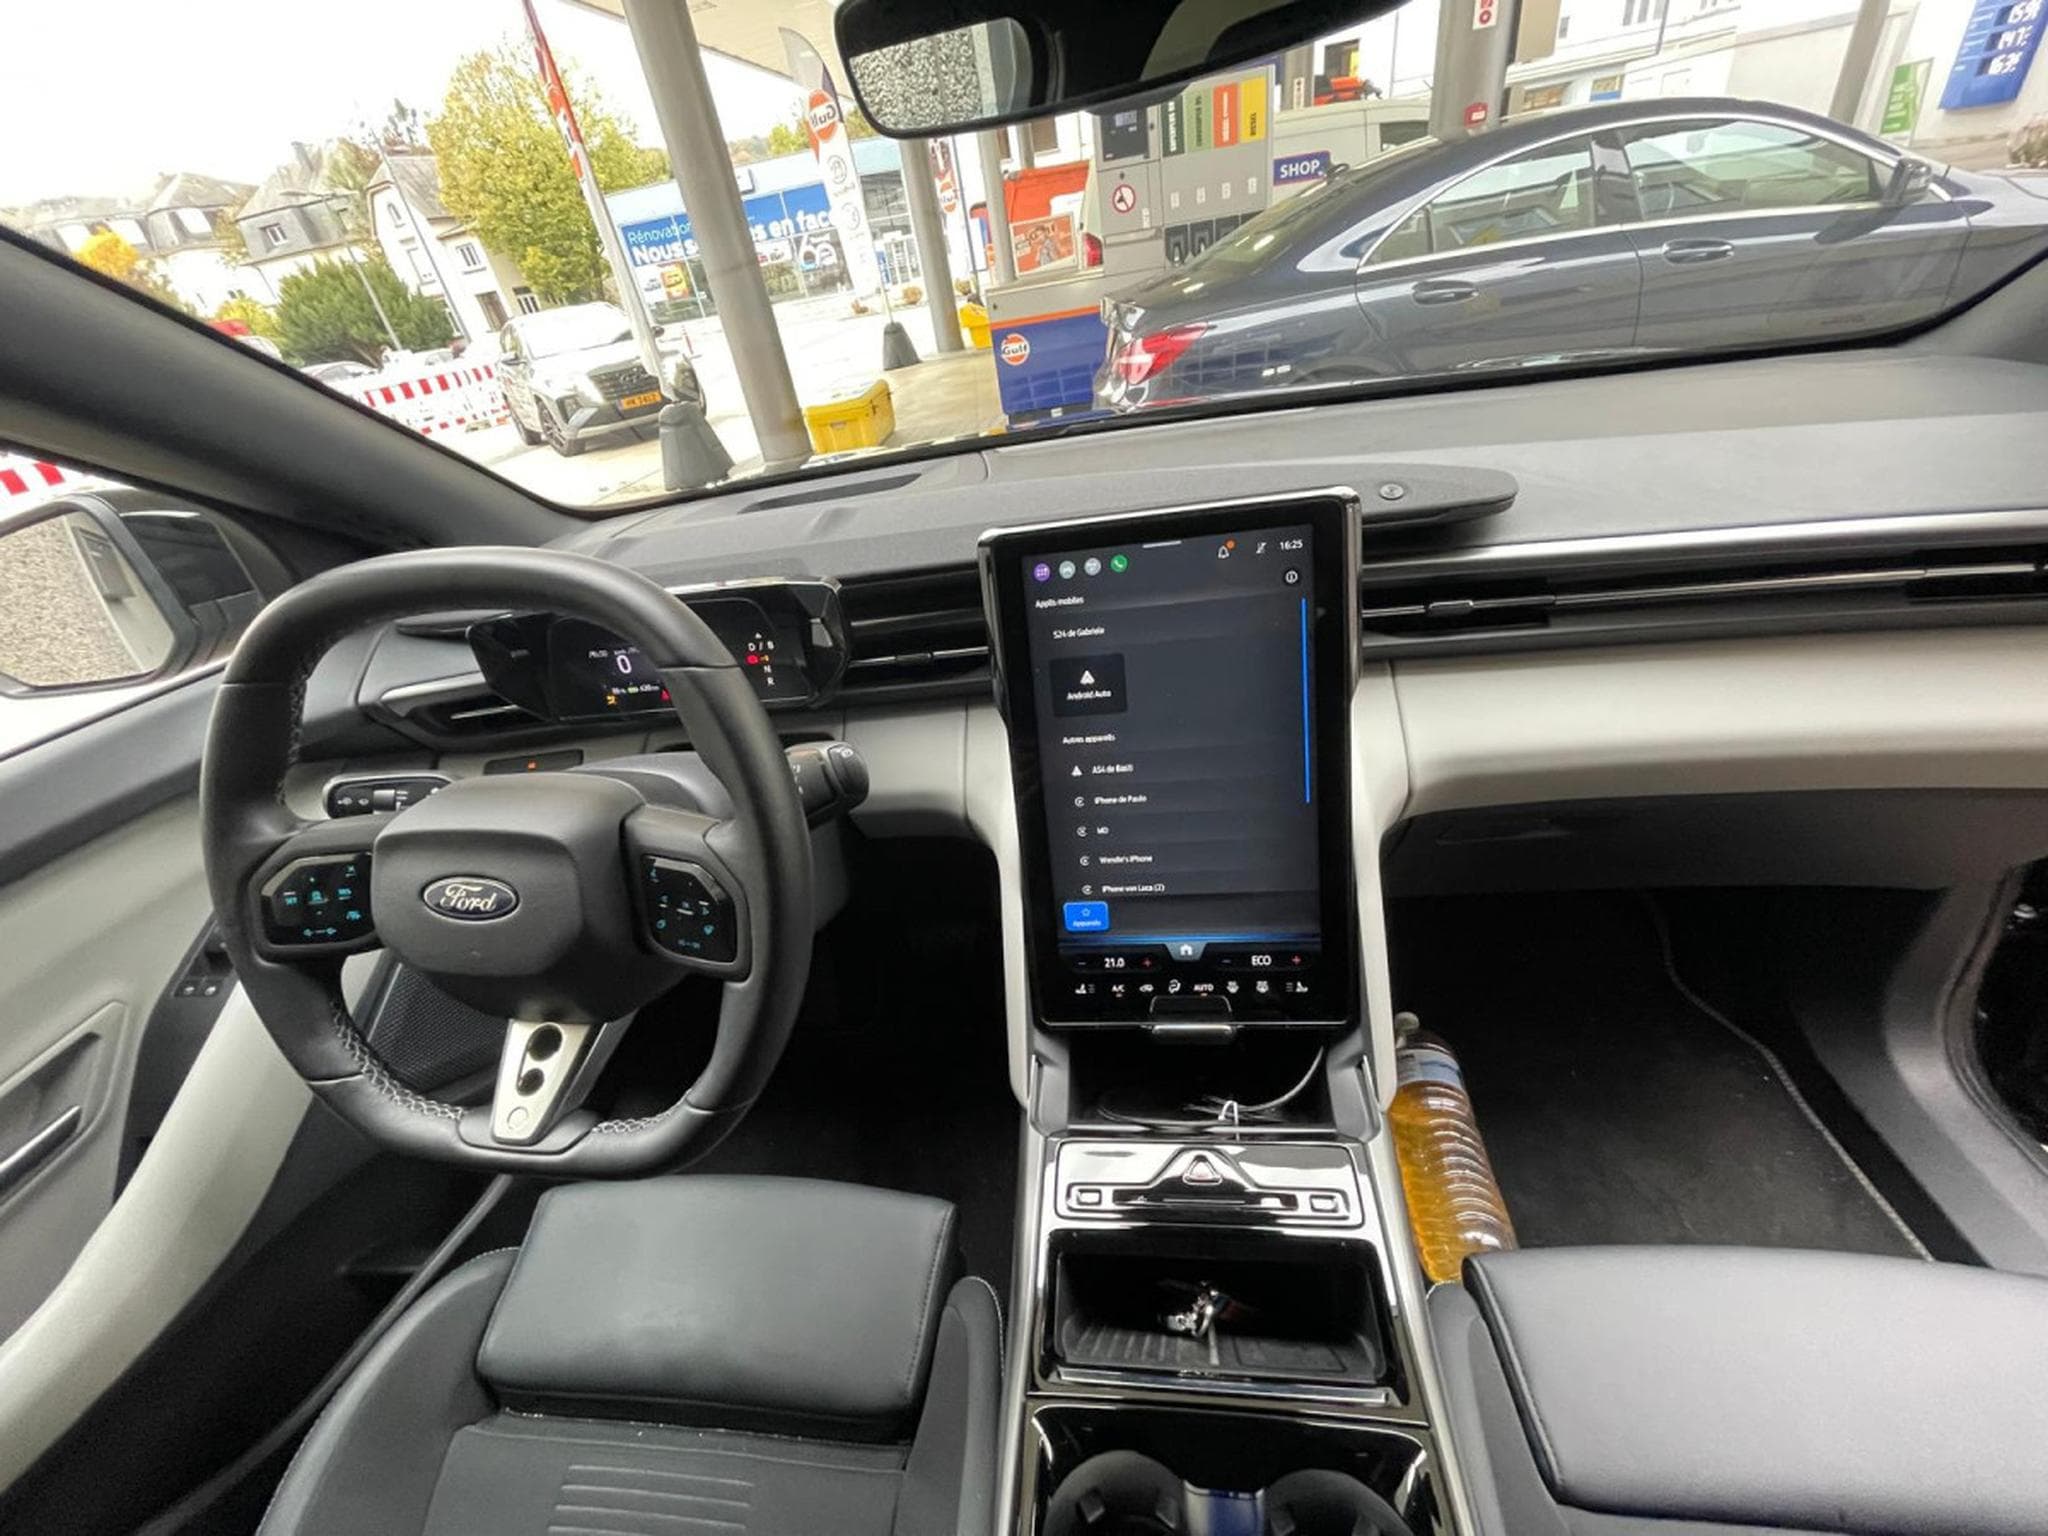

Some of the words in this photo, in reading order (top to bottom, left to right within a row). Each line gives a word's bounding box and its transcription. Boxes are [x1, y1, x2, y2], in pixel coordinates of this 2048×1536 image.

[1280, 159, 1320, 178] SHOP
[796, 208, 831, 234] fac
[627, 221, 692, 245] Rénovatio
[1002, 343, 1027, 355] Gulf
[1280, 539, 1303, 550] 16:25
[1058, 596, 1084, 605] mobiles
[616, 654, 632, 674] 0
[1118, 795, 1127, 803] de
[440, 883, 497, 912] Ford
[1104, 957, 1126, 968] 21.0
[1251, 955, 1273, 966] ECO
[1193, 983, 1214, 993] AUTO
